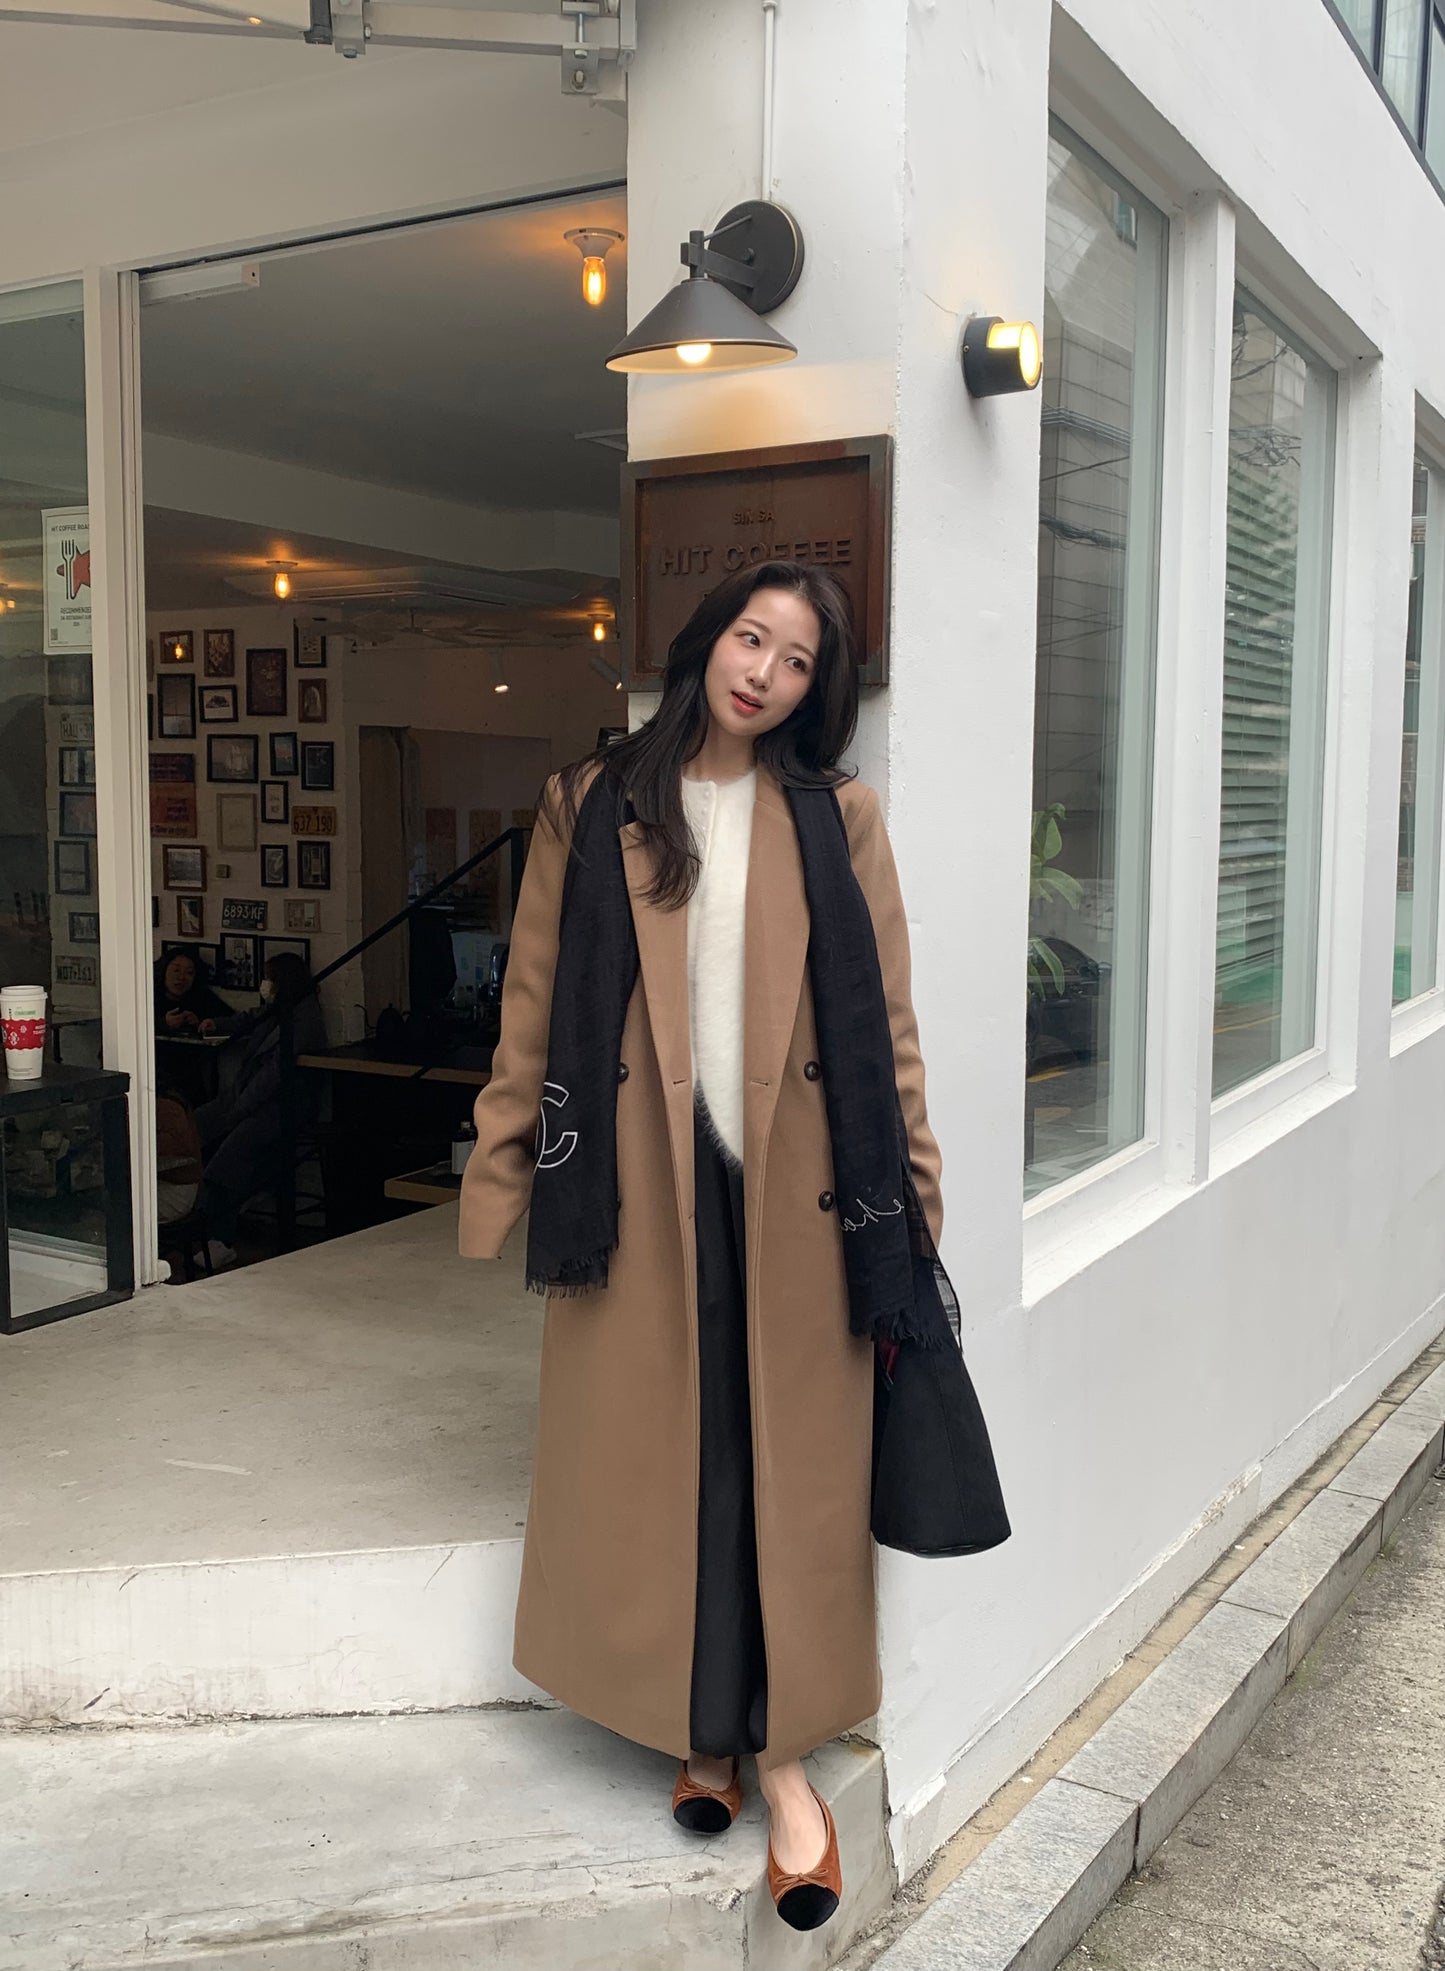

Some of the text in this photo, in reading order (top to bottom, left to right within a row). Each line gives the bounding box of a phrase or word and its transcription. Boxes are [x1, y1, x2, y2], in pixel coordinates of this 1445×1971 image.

[732, 510, 776, 526] SIN SA
[661, 543, 712, 576] HIT
[224, 904, 249, 919] 6893
